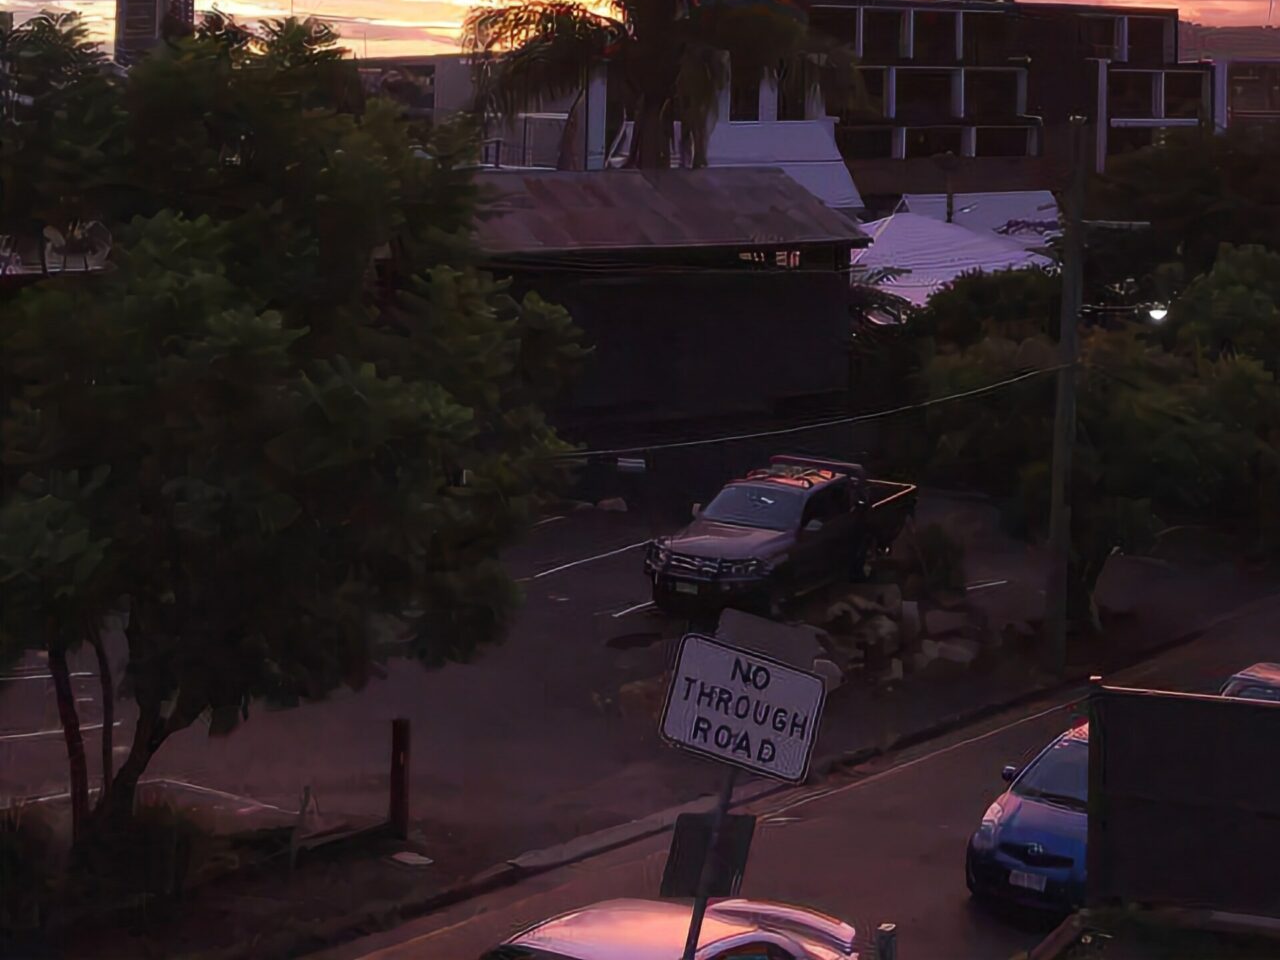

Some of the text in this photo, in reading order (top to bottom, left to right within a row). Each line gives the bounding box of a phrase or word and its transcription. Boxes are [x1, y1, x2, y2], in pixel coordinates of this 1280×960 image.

[731, 658, 770, 690] NO
[684, 677, 808, 740] THROUGH
[692, 717, 776, 763] ROAD
